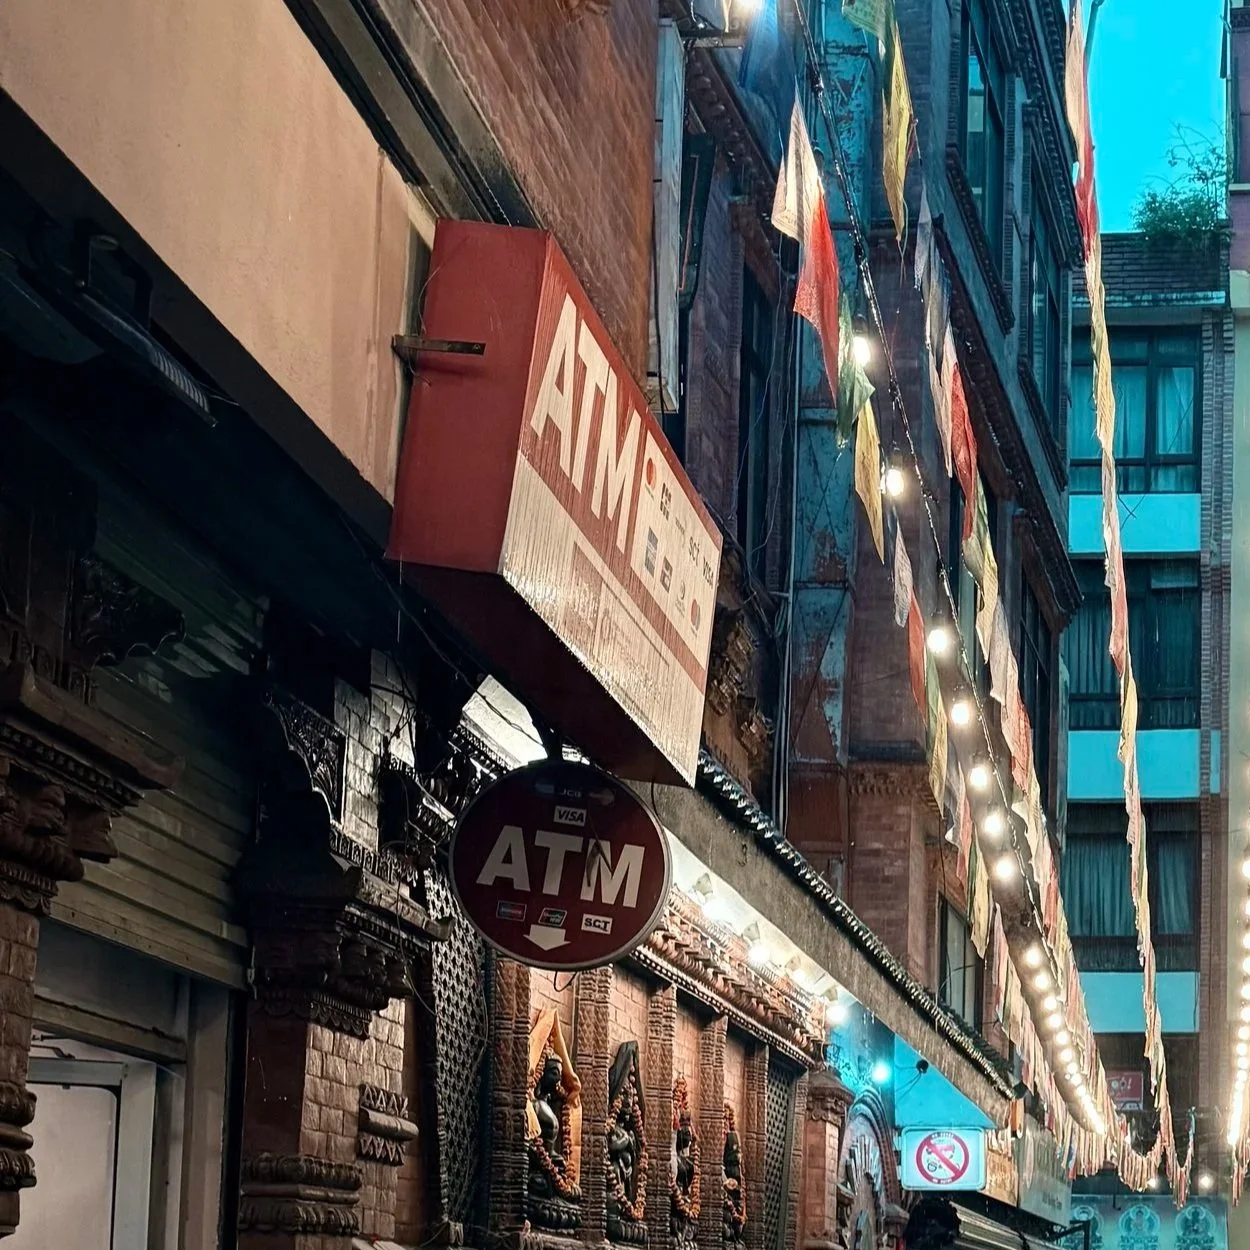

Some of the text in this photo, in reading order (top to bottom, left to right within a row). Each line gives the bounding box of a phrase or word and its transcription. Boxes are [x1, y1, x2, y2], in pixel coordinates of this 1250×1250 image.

[530, 291, 641, 556] ATM
[557, 809, 585, 824] VISA
[476, 824, 646, 909] ATM
